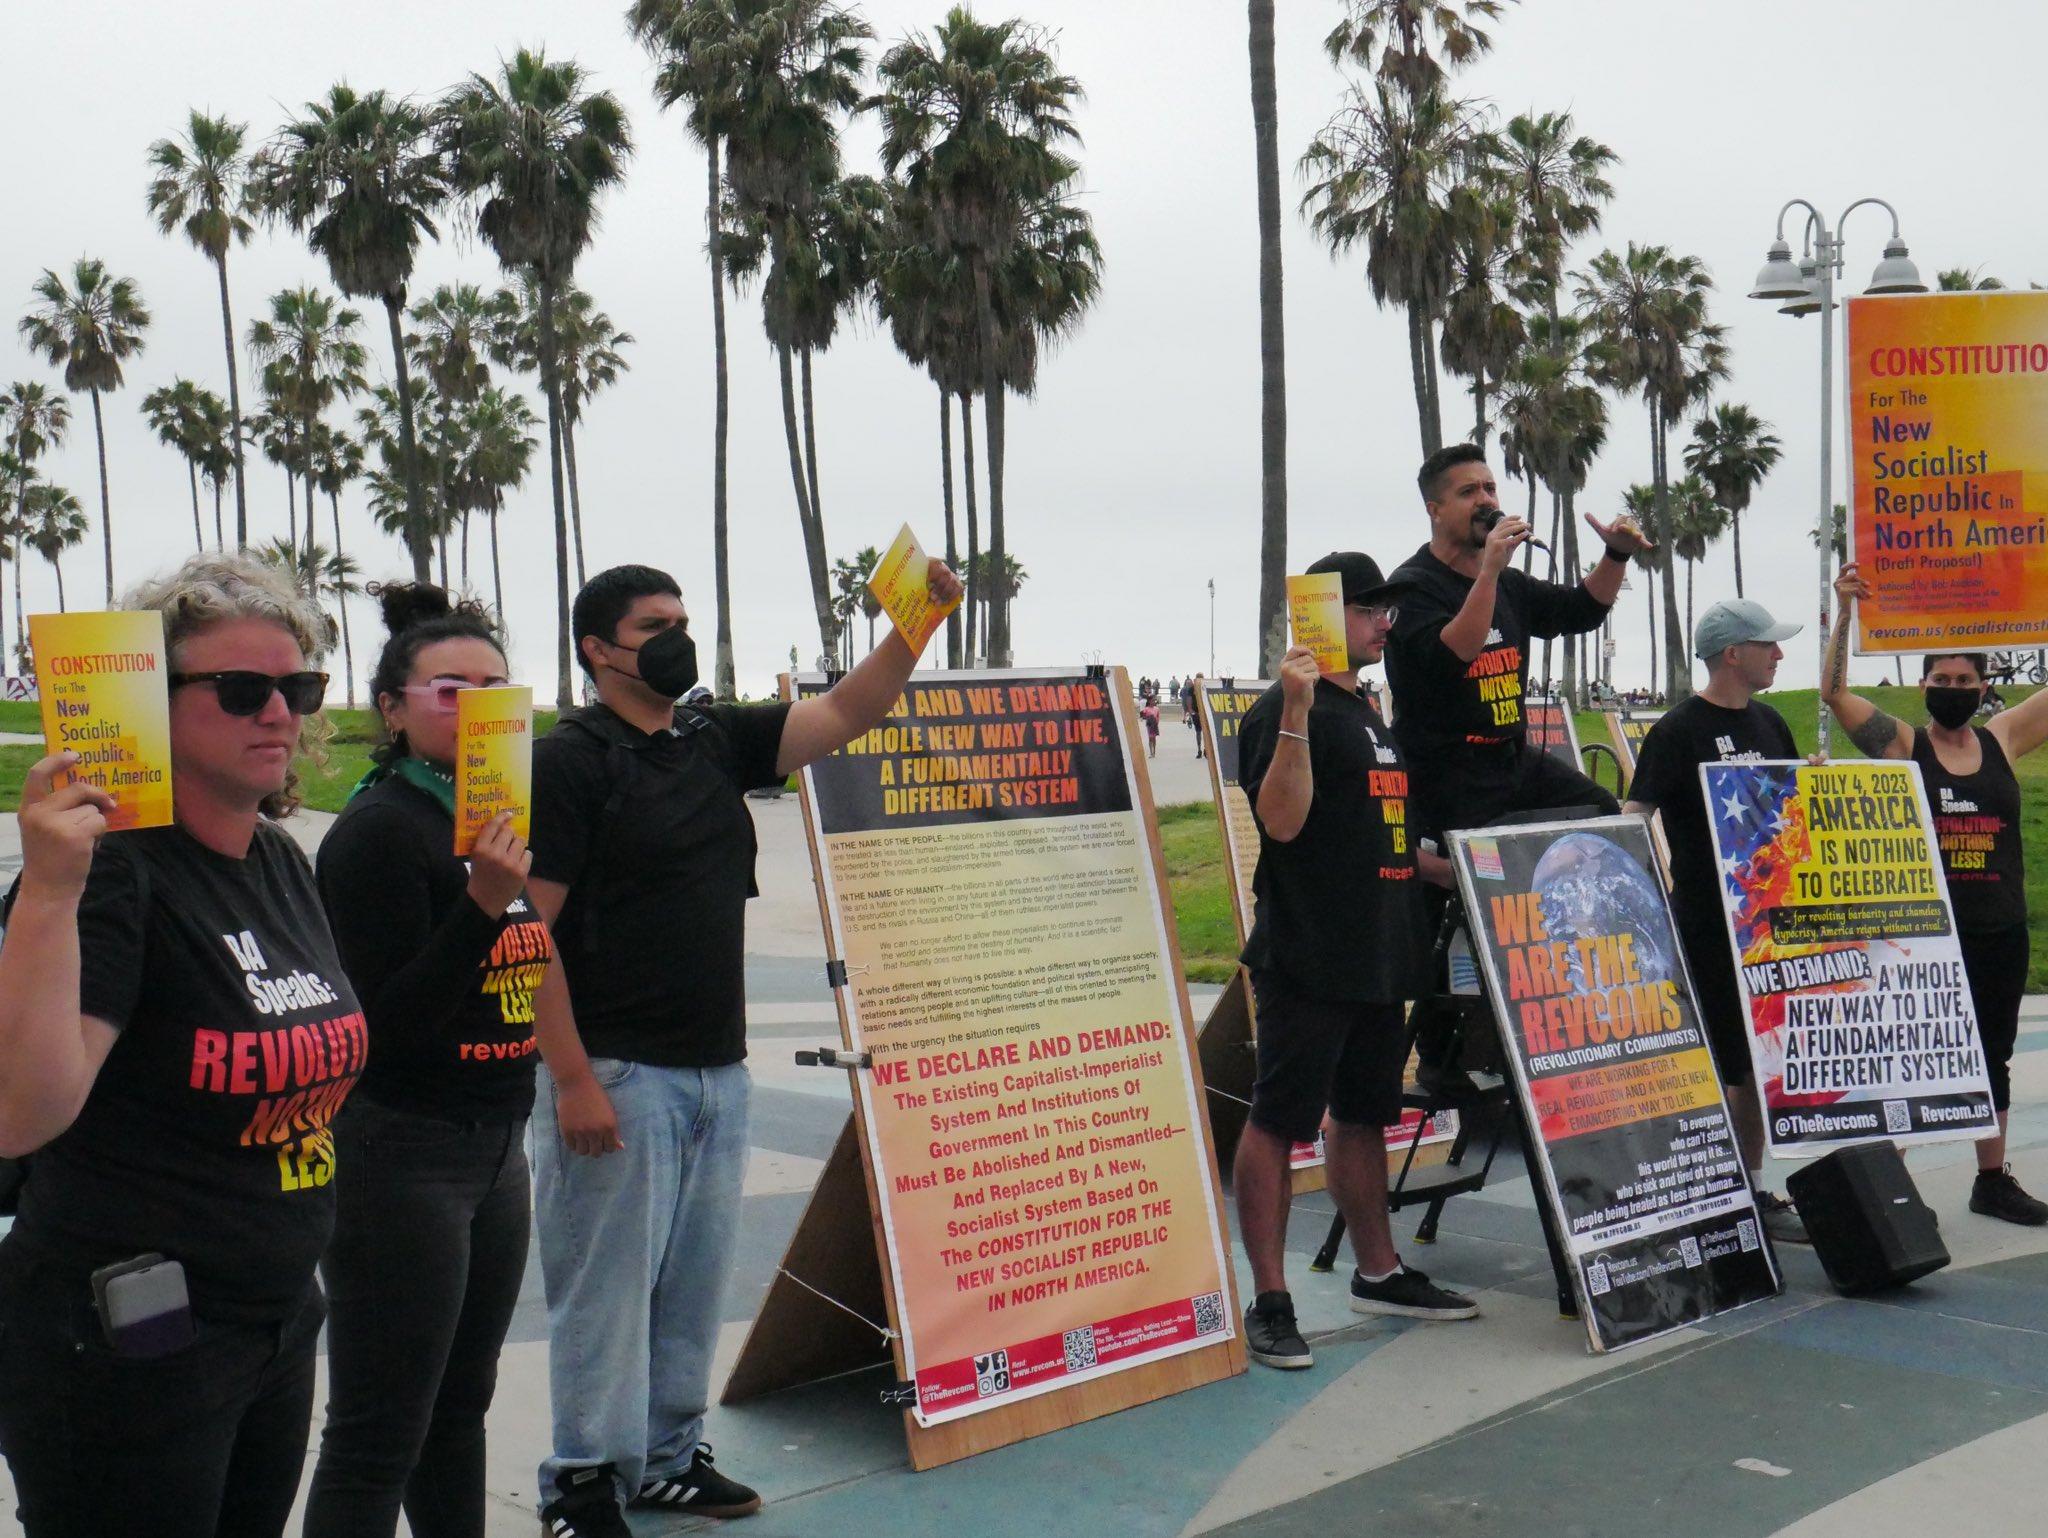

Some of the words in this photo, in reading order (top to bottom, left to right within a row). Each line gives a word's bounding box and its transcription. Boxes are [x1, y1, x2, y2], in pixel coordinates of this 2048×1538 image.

[1870, 392, 1894, 407] For
[1900, 389, 1927, 405] The
[1872, 416, 1931, 443] New
[1873, 446, 1987, 479] Socialist
[1874, 481, 1992, 519] Republic
[1875, 518, 1952, 550] North
[1875, 557, 1914, 573] (Draft
[1920, 552, 1983, 570] Proposal)
[1295, 592, 1338, 604] CONSTITUTION
[51, 653, 155, 676] CONSTITUTION
[56, 700, 89, 717] New
[916, 689, 963, 716] AND
[967, 688, 1006, 715] WE
[1010, 684, 1109, 713] DEMAND:
[1209, 694, 1233, 713] WE
[60, 719, 121, 742] Socialist
[468, 719, 526, 736] CONSTITUTION
[847, 727, 923, 754] WHOLE
[928, 725, 975, 749] NEW
[981, 723, 1027, 749] WAY
[1032, 720, 1059, 745] TO
[1065, 719, 1108, 744] LIVE,
[467, 754, 486, 767] New
[1715, 735, 1735, 754] BA
[112, 767, 162, 786] America
[467, 769, 502, 785] Socialist
[880, 760, 895, 785] A
[902, 751, 1071, 784] FUNDAMENTALLY
[885, 784, 993, 815] DIFFERENT
[1000, 778, 1078, 806] SYSTEM
[1811, 774, 1846, 795] JULY
[1852, 775, 1867, 801] 4,
[1873, 773, 1908, 794] 2023
[1940, 788, 1953, 800] BA
[1809, 796, 1921, 832] AMERICA
[1942, 800, 1978, 813] Speaks:
[1820, 839, 1840, 865] IS
[1845, 838, 1928, 864] NOTHING
[1940, 834, 1994, 850] NOTHING
[1951, 852, 1985, 868] LESS!
[1798, 872, 1822, 898] TO
[1830, 868, 1934, 897] CELEBRATE!
[1491, 892, 1547, 946] WE
[1793, 908, 1806, 927] for
[1809, 908, 1845, 925] revolting
[1848, 906, 1887, 923] barbarity
[1888, 906, 1904, 916] and
[1906, 904, 1941, 916] shameless
[1821, 924, 1853, 936] America
[1856, 923, 1880, 938] reigns
[1883, 920, 1912, 932] without
[223, 931, 267, 971] BA
[1507, 942, 1574, 1000] ARE
[1576, 933, 1641, 989] THE
[1744, 963, 1780, 994] WE
[1782, 950, 1871, 990] DEMAND:
[1879, 964, 1890, 991] A
[1897, 962, 1961, 989] WHOLE
[246, 970, 338, 1015] Speaks:
[1520, 980, 1681, 1055] REVCOMS
[1789, 998, 1834, 1027] NEW
[1842, 995, 1885, 1023] WAY
[1893, 993, 1916, 1021] TO
[1924, 991, 1968, 1021] LIVE,
[868, 1043, 889, 1054] With
[892, 1040, 908, 1051] the
[911, 1034, 946, 1049] urgency
[949, 1031, 963, 1043] the
[965, 1026, 1003, 1041] situation
[1005, 1022, 1040, 1035] requires
[871, 1061, 911, 1086] WE
[917, 1044, 1020, 1079] DECLARE
[1028, 1035, 1071, 1061] AND
[1078, 1021, 1172, 1054] DEMAND:
[1530, 1044, 1621, 1075] (REVOLUTIONARY
[1625, 1028, 1700, 1054] COMMUNISTS)
[1786, 1032, 1799, 1059] A
[1807, 1020, 1973, 1057] FUNDAMENTALLY
[894, 1092, 926, 1111] The
[932, 1078, 999, 1106] Existing
[1003, 1051, 1163, 1091] Capitalist-Imperialist
[1787, 1056, 1893, 1090] DIFFERENT
[1901, 1050, 1980, 1082] SYSTEM!
[930, 1108, 990, 1132] System
[997, 1102, 1026, 1119] And
[1032, 1088, 1119, 1113] Institutions
[1124, 1079, 1141, 1096] Of
[1776, 1113, 1878, 1137] @TheRevcoms
[1921, 1104, 1990, 1123] Revcom.us
[929, 1128, 1029, 1158] Government
[1035, 1122, 1048, 1138] In
[1053, 1115, 1087, 1135] This
[1092, 1104, 1150, 1128] Country
[1678, 1119, 1688, 1132] To
[1690, 1113, 1723, 1130] everyone
[1670, 1138, 1685, 1151] who
[1687, 1132, 1706, 1147] can't
[1708, 1127, 1728, 1142] stand
[895, 1171, 936, 1192] Must
[944, 1164, 965, 1183] Be
[972, 1148, 1049, 1178] Abolished
[1055, 1142, 1084, 1161] And
[1653, 1155, 1677, 1172] world
[1678, 1153, 1690, 1165] the
[1691, 1150, 1707, 1163] way
[953, 1191, 985, 1209] And
[991, 1174, 1065, 1202] Replaced
[1069, 1168, 1088, 1186] By
[1094, 1166, 1104, 1179] A
[1109, 1158, 1146, 1177] New,
[1616, 1186, 1633, 1200] who
[1660, 1174, 1676, 1189] and
[1717, 1161, 1737, 1172] many
[947, 1208, 1020, 1238] Socialist
[1025, 1196, 1082, 1222] System
[1087, 1182, 1133, 1207] Based
[1138, 1178, 1158, 1194] On
[1573, 1210, 1603, 1232] people
[1605, 1205, 1629, 1222] being
[1671, 1189, 1687, 1203] less
[940, 1248, 972, 1267] The
[978, 1218, 1101, 1259] CONSTITUTION
[1107, 1208, 1137, 1229] FOR
[1141, 1199, 1172, 1222] THE
[956, 1267, 994, 1292] NEW
[1001, 1245, 1086, 1280] SOCIALIST
[1092, 1227, 1169, 1258] REPUBLIC
[988, 1295, 1005, 1312] IN
[1011, 1278, 1068, 1307] NORTH
[1074, 1258, 1150, 1289] AMERICA.
[922, 1382, 975, 1403] @TheRevcoms
